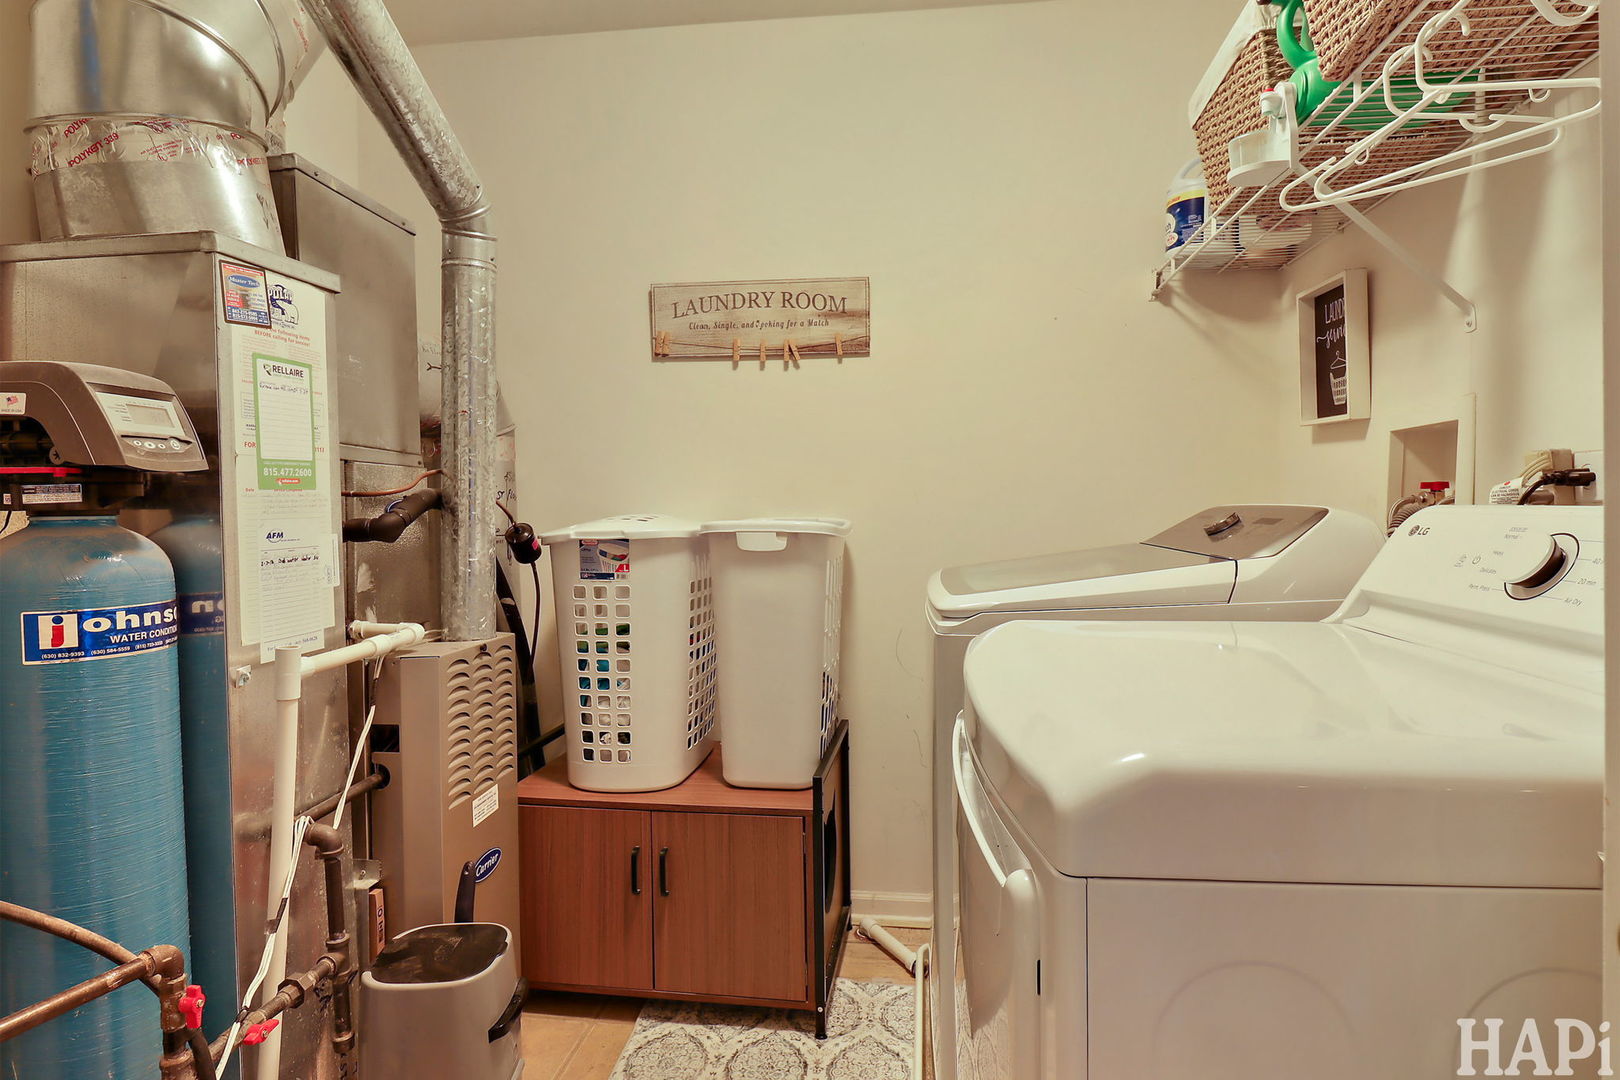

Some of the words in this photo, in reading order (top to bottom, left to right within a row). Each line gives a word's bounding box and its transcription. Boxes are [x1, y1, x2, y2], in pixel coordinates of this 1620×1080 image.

[104, 132, 119, 144] 339
[672, 292, 775, 319] LAUNDRY
[780, 291, 847, 314] ROOM
[786, 320, 797, 329] for
[272, 365, 304, 378] RELLAIRE
[264, 468, 312, 476] 815.477.2600
[1418, 527, 1430, 536] LG
[110, 632, 147, 643] WATER
[476, 853, 499, 877] Carrier
